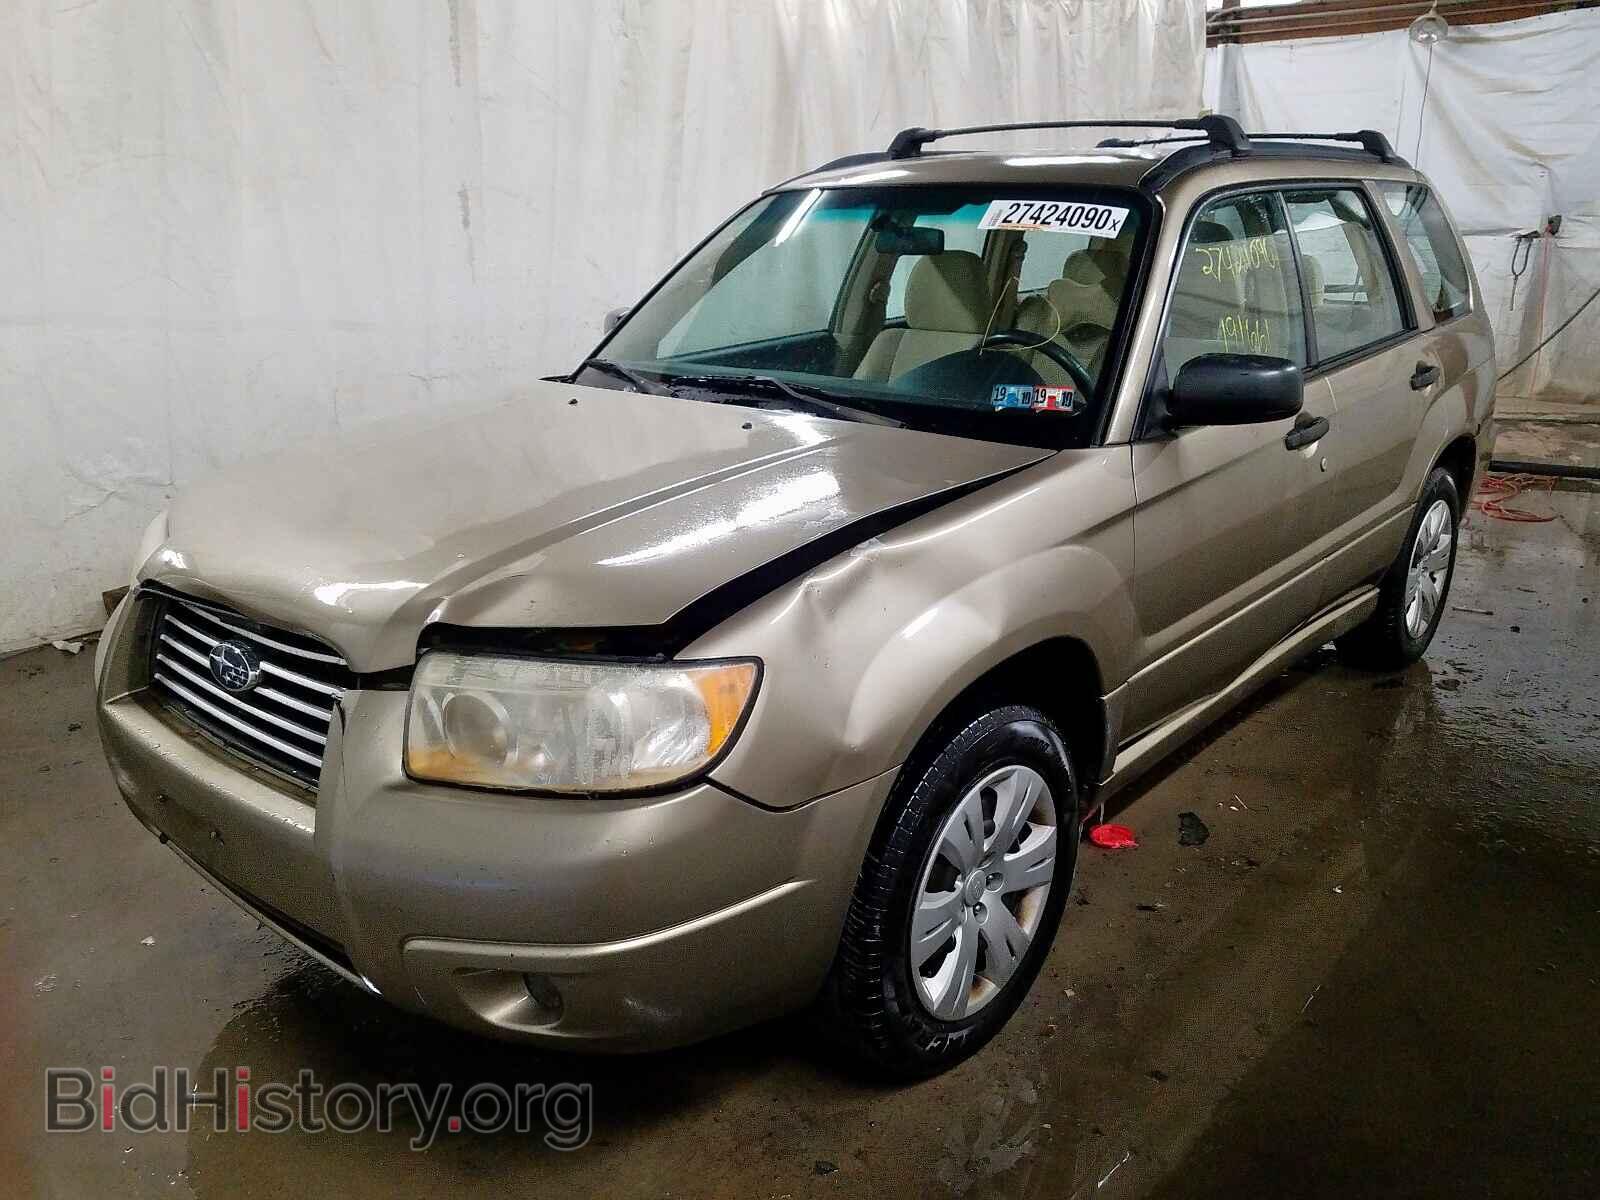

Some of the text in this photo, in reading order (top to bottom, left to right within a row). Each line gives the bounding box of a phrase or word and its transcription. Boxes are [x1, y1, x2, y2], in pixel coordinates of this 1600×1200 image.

[1000, 202, 1113, 231] 27424090
[993, 386, 1007, 402] 19
[1033, 388, 1047, 404] 19
